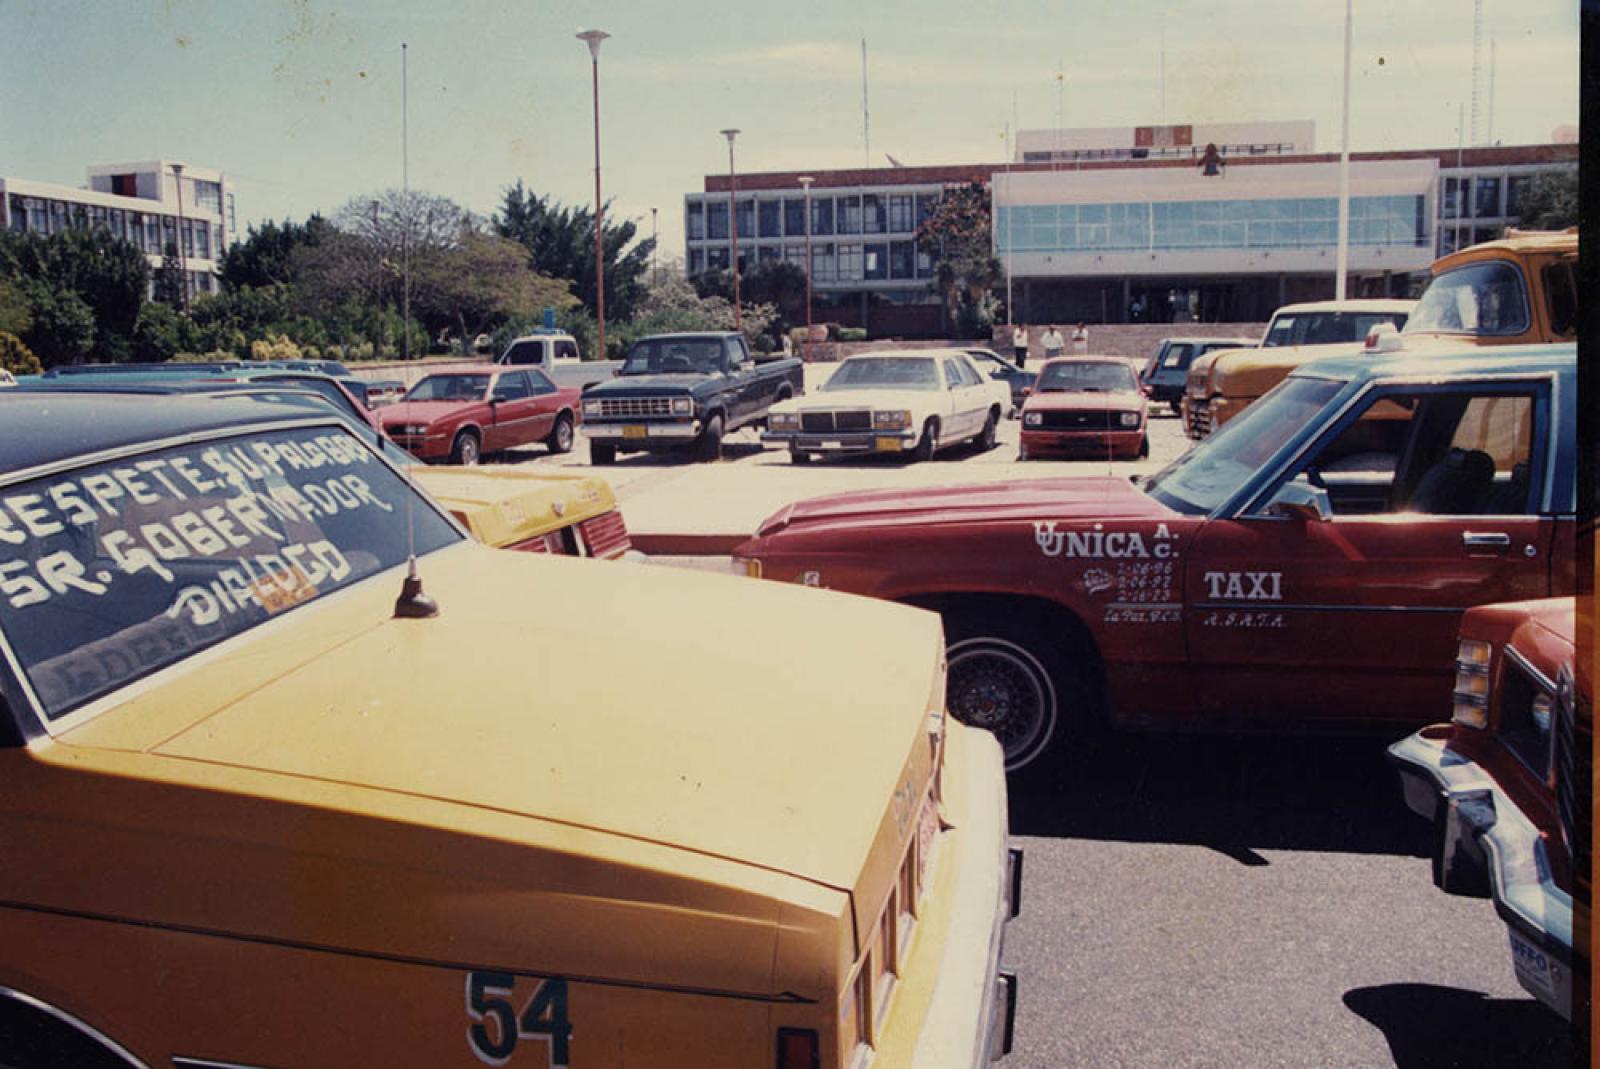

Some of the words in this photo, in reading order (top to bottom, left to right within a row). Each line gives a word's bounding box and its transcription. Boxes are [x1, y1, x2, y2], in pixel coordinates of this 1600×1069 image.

[0, 551, 112, 608] SR.
[101, 474, 393, 582] GOBERNADOR
[166, 539, 352, 625] DIALOGO
[1204, 572, 1282, 599] TAXI
[464, 972, 574, 1069] 54
